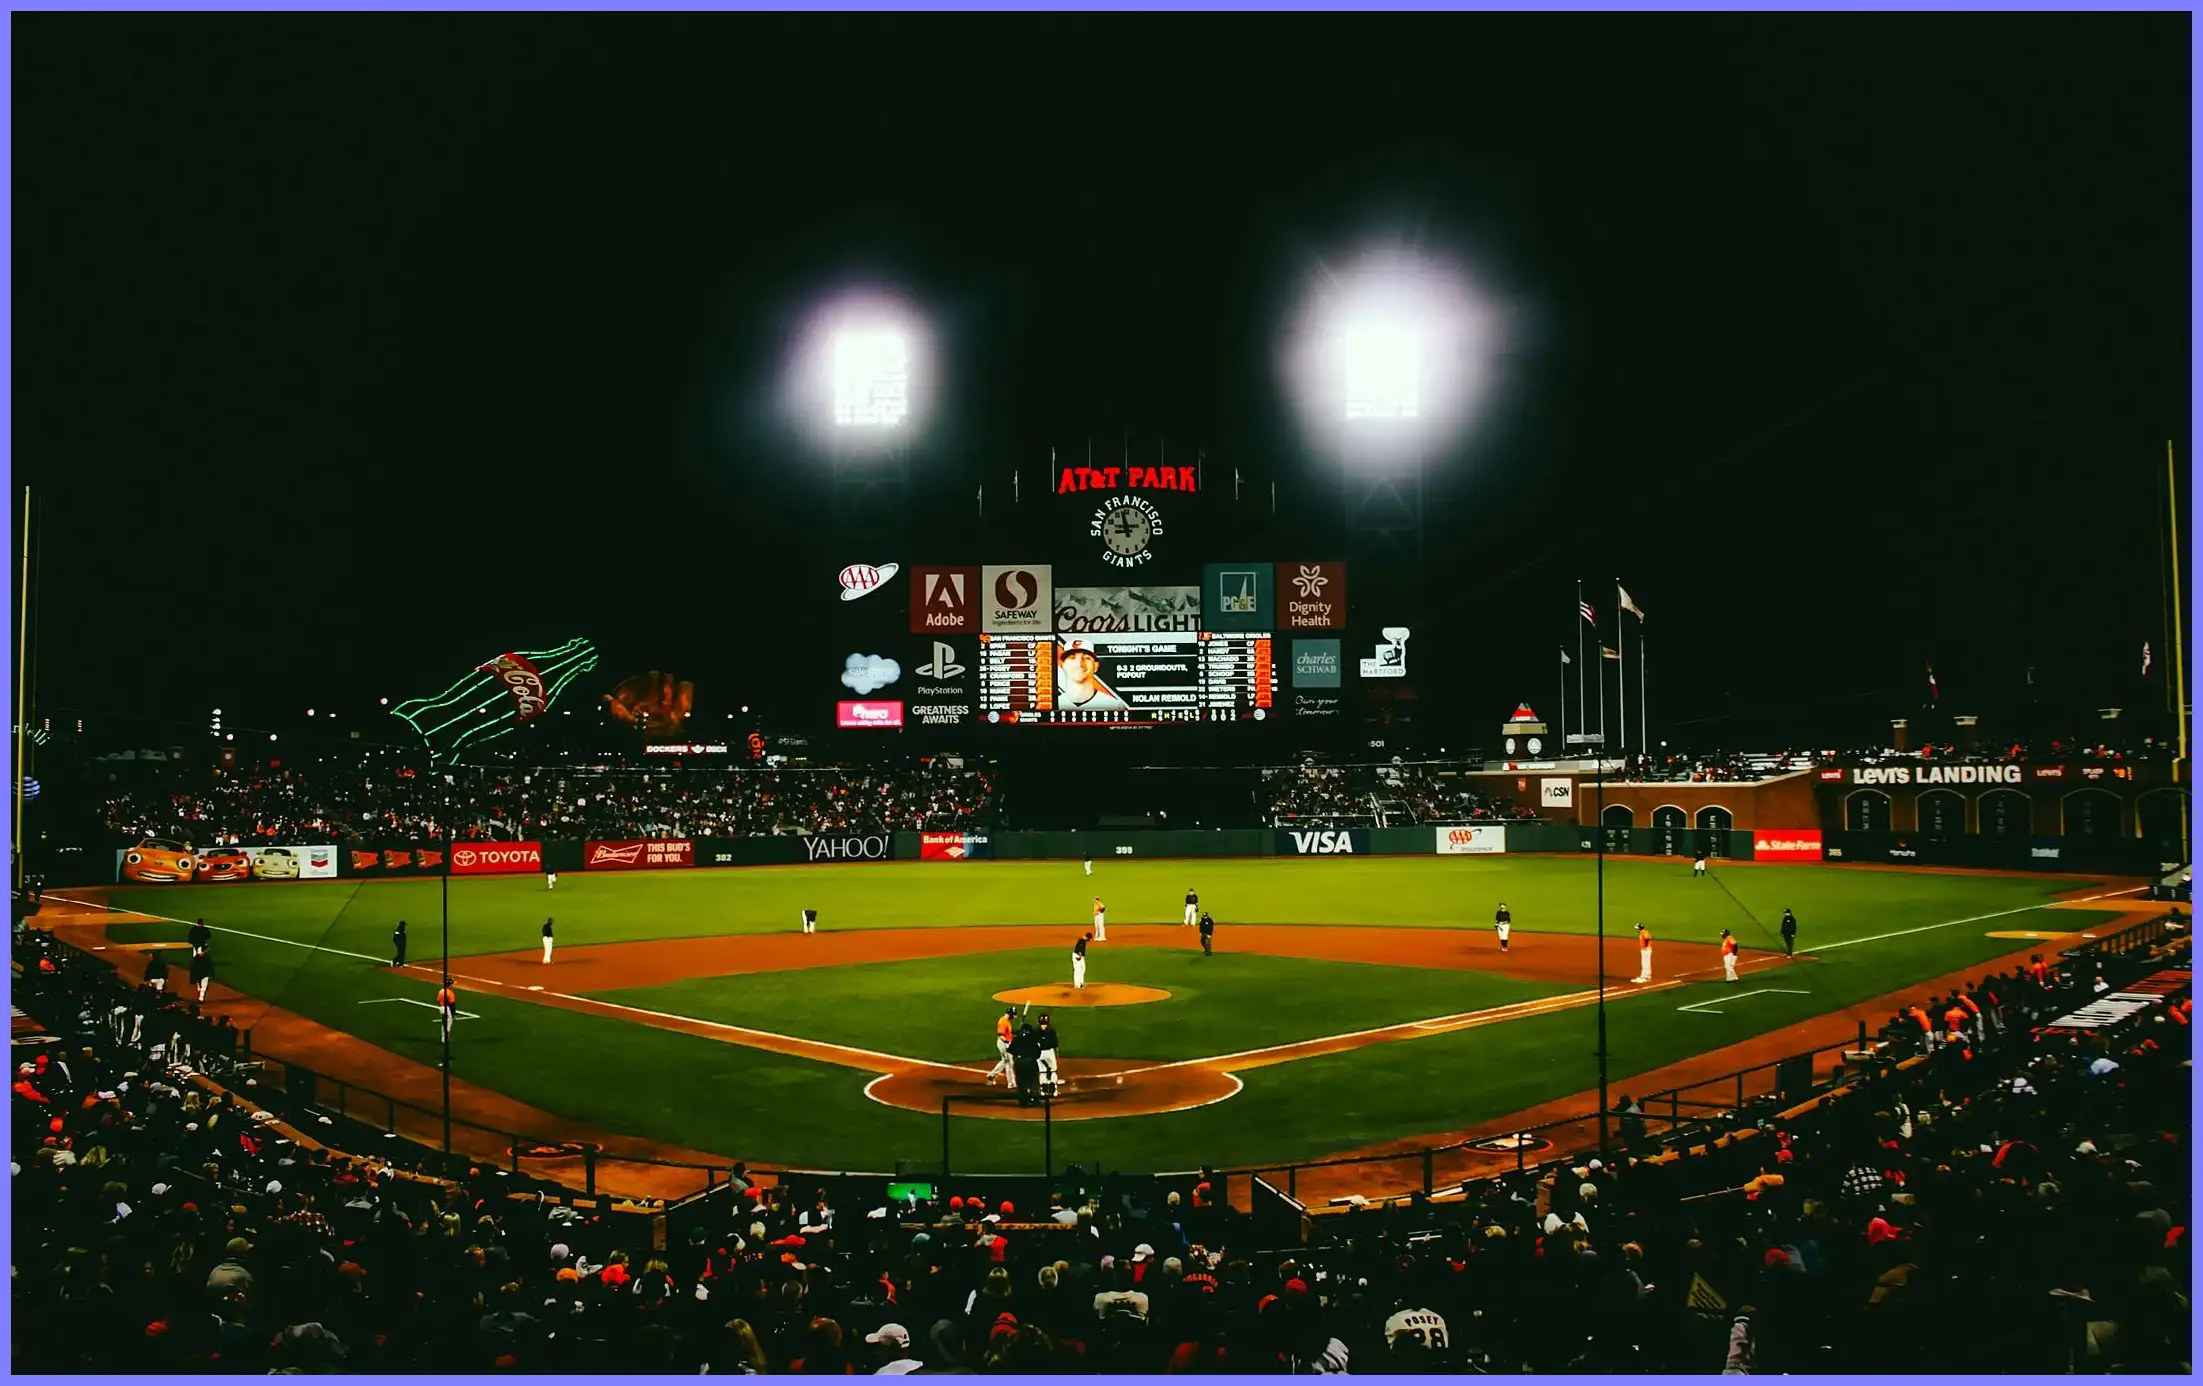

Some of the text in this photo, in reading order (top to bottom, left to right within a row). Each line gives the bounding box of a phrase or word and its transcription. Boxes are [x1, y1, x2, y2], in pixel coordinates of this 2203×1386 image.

[1058, 466, 1196, 494] AT&T PARK
[1090, 495, 1163, 536] SAN FRANCISCO
[1102, 549, 1152, 567] GIANTS
[845, 567, 880, 590] AAA
[1289, 602, 1331, 615] Dignity
[926, 613, 965, 626] Adobe
[995, 610, 1038, 619] SAFEWAY
[1054, 605, 1200, 632] Coors LIGHT
[1291, 615, 1330, 626] Health
[1107, 645, 1177, 653] TONIGHT'S GAME
[1297, 652, 1335, 664] charles
[1135, 664, 1188, 672] GROUNDOUTS,
[1296, 664, 1337, 674] SCHWAB
[1117, 671, 1146, 679] POPOUT
[504, 670, 545, 716] Cola
[917, 686, 963, 696] PlayStation
[1132, 695, 1160, 703] NOLAN
[912, 705, 969, 715] GREATNESS
[922, 714, 960, 724] AWAITS
[646, 745, 688, 753] DOCKERS
[1916, 765, 2022, 783] LANDING
[1553, 787, 1570, 797] CSN
[923, 835, 988, 844] Bank of America
[1288, 830, 1353, 853] VISA
[1449, 829, 1473, 845] AAA
[647, 842, 691, 852] THIS BUD'S
[803, 835, 889, 860] YAHOO!
[1115, 846, 1133, 854] 399
[1770, 840, 1821, 851] State Farm
[479, 850, 541, 863] TOYOTA
[647, 853, 682, 863] FOR YOU.
[1404, 1315, 1439, 1327] POSEY
